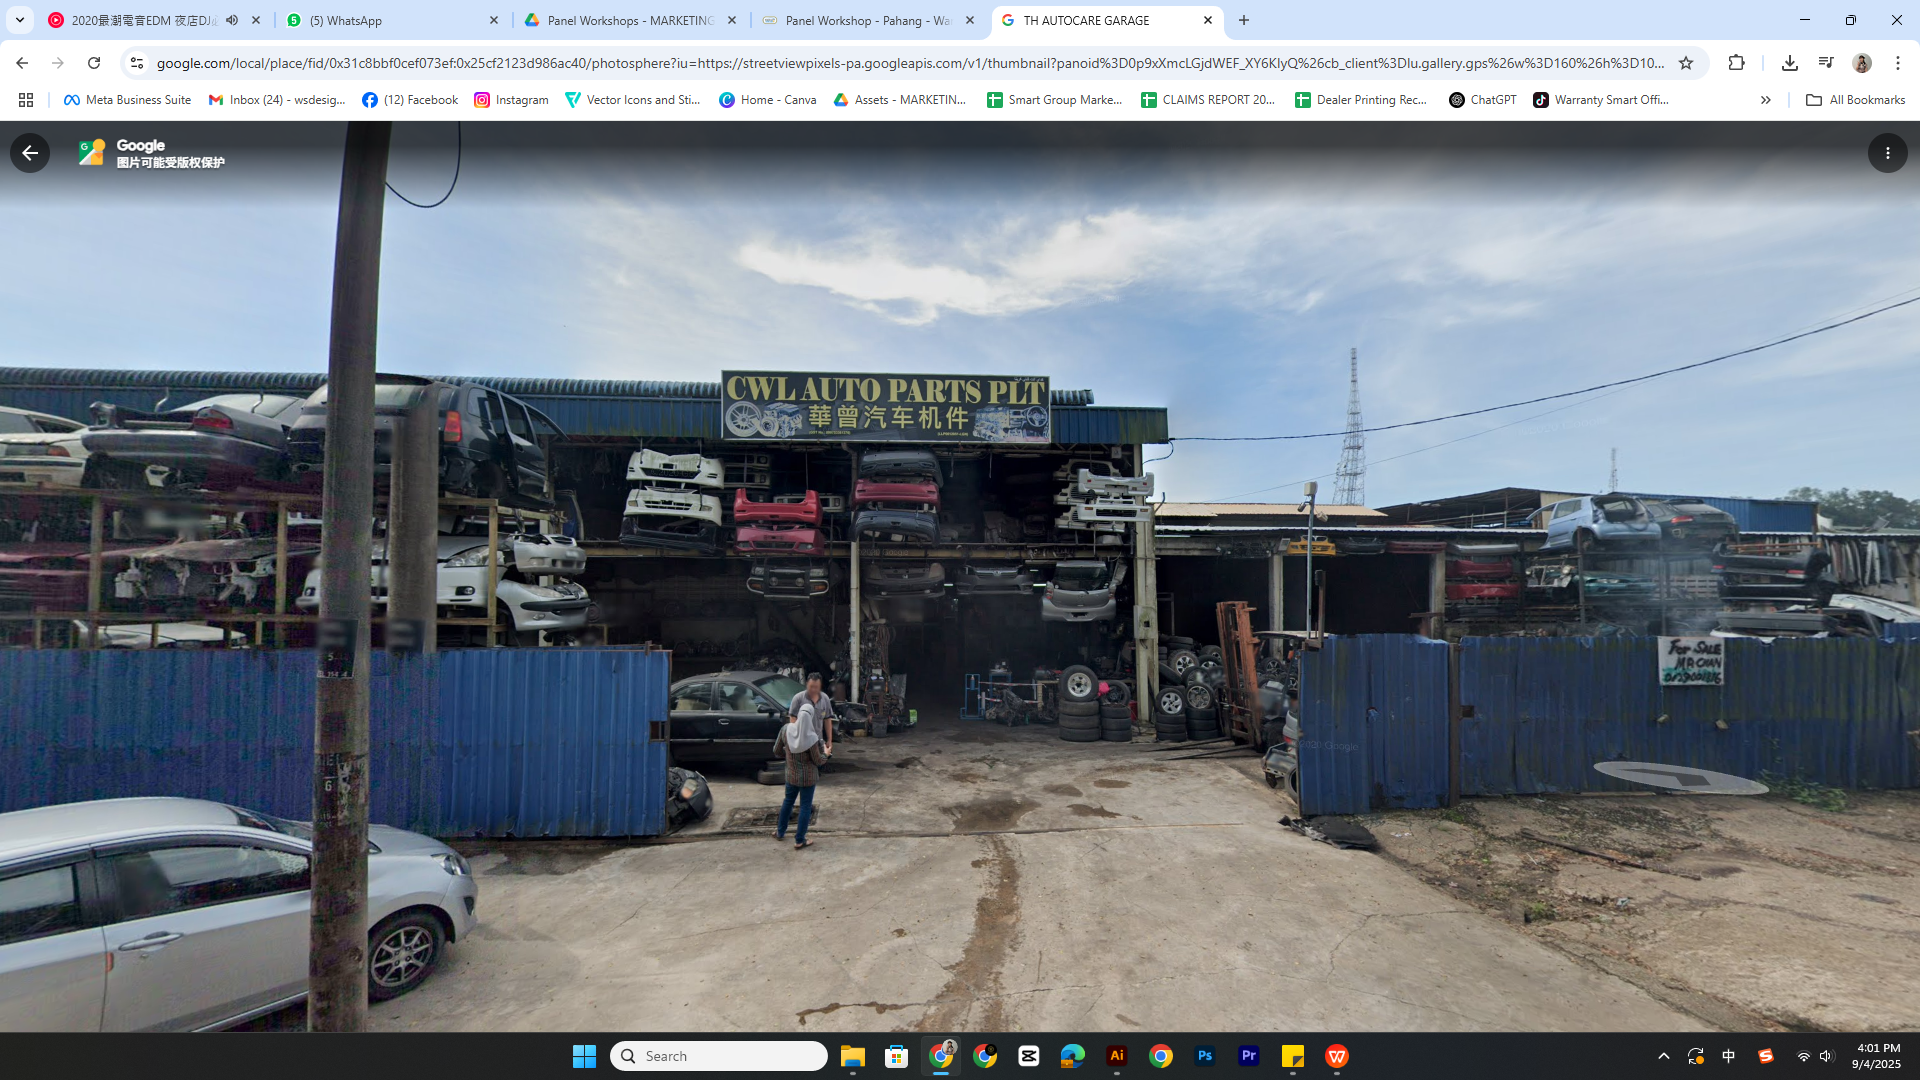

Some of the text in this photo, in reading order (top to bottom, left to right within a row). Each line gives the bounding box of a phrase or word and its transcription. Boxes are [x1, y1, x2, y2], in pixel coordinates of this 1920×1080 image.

[310, 15, 383, 29] (5) WhatsApp
[548, 15, 577, 26] Panel
[579, 15, 639, 29] Workshops
[786, 15, 815, 26] Panel
[817, 15, 872, 29] Workshop
[883, 15, 922, 29] Pahang
[1023, 15, 1150, 26] TH AUTOCARE GARAGE
[86, 94, 192, 105] Meta Business Suite
[230, 94, 261, 105] Inbox
[263, 94, 284, 107] (24)
[384, 94, 459, 107] (12) Facebook
[496, 94, 549, 108] Instagram
[586, 94, 622, 105] Vector
[624, 94, 653, 105] Icons
[654, 94, 676, 105] and
[741, 94, 774, 105] Home
[784, 94, 817, 105] Canva
[854, 94, 889, 105] Assets
[1008, 94, 1041, 105] Smart
[1043, 94, 1077, 108] Group
[1162, 94, 1205, 105] CLAIMS
[1208, 94, 1251, 105] REPORT
[1317, 94, 1353, 105] Dealer
[1354, 94, 1396, 108] Printing
[1470, 94, 1518, 105] ChatGPT
[1554, 94, 1604, 108] Warranty
[1606, 94, 1639, 105] Smart
[1829, 94, 1906, 105] All Bookmarks
[726, 374, 1046, 405] CWL AUTO PARTS PLT
[808, 404, 970, 430] 華曾汽车机件
[1668, 638, 1721, 655] For SALE
[1696, 657, 1721, 669] CHAN
[1857, 1043, 1901, 1053] 4:01 PM
[646, 1050, 687, 1062] Search
[1110, 1049, 1124, 1061] Ai
[1198, 1050, 1213, 1061] Ps
[1242, 1050, 1257, 1061] Pr
[1722, 1048, 1735, 1064] 中
[1851, 1059, 1902, 1071] 9/4/2025
